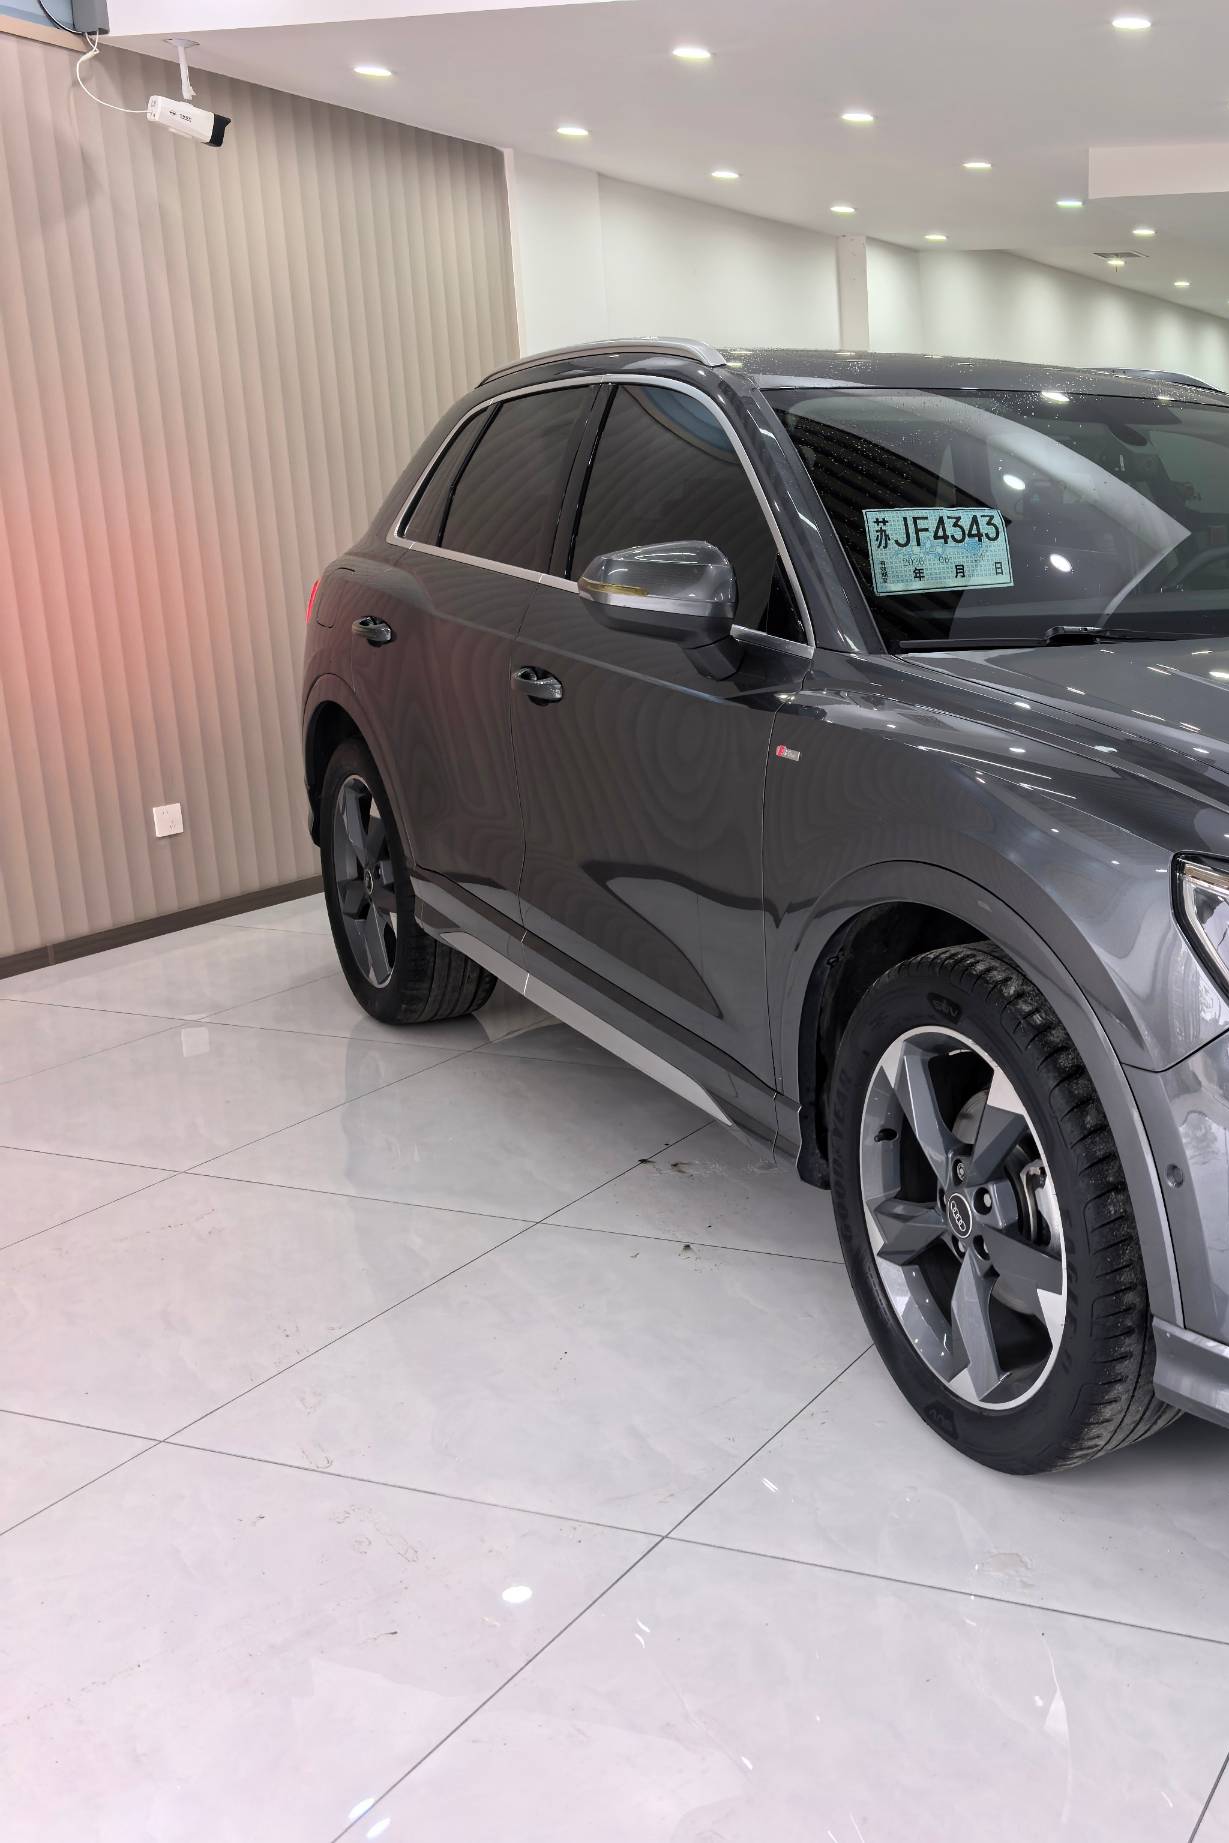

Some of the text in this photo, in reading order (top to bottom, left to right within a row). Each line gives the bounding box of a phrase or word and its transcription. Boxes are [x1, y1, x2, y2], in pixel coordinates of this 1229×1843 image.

[873, 514, 1000, 550] 苏JF4343
[955, 564, 966, 578] 月
[994, 561, 1004, 576] 日
